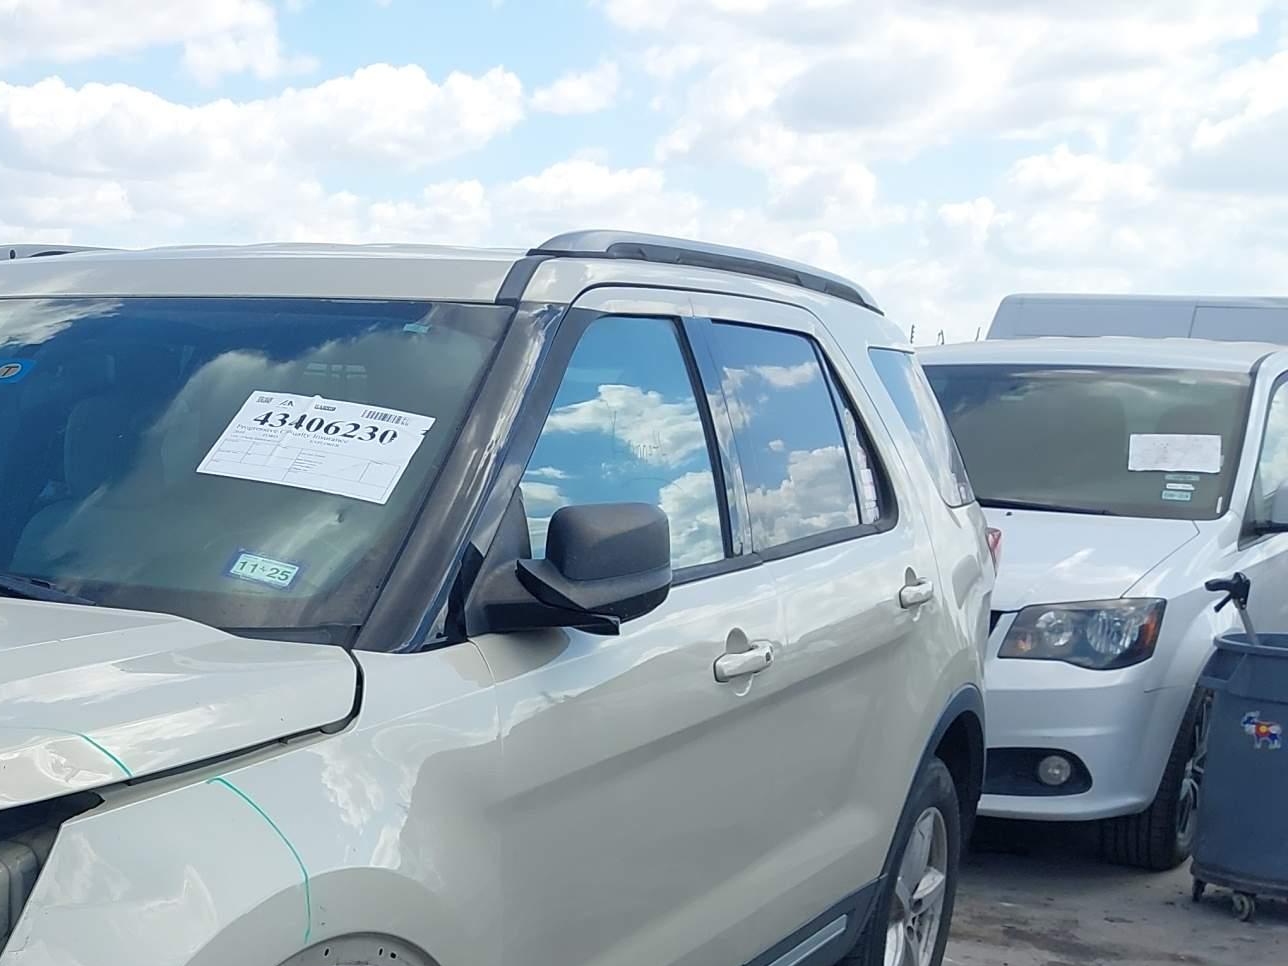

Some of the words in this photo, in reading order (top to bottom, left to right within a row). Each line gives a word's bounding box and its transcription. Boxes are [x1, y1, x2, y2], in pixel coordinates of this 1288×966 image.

[253, 410, 398, 446] 43406230
[239, 560, 259, 574] 11
[265, 567, 292, 581] 25
